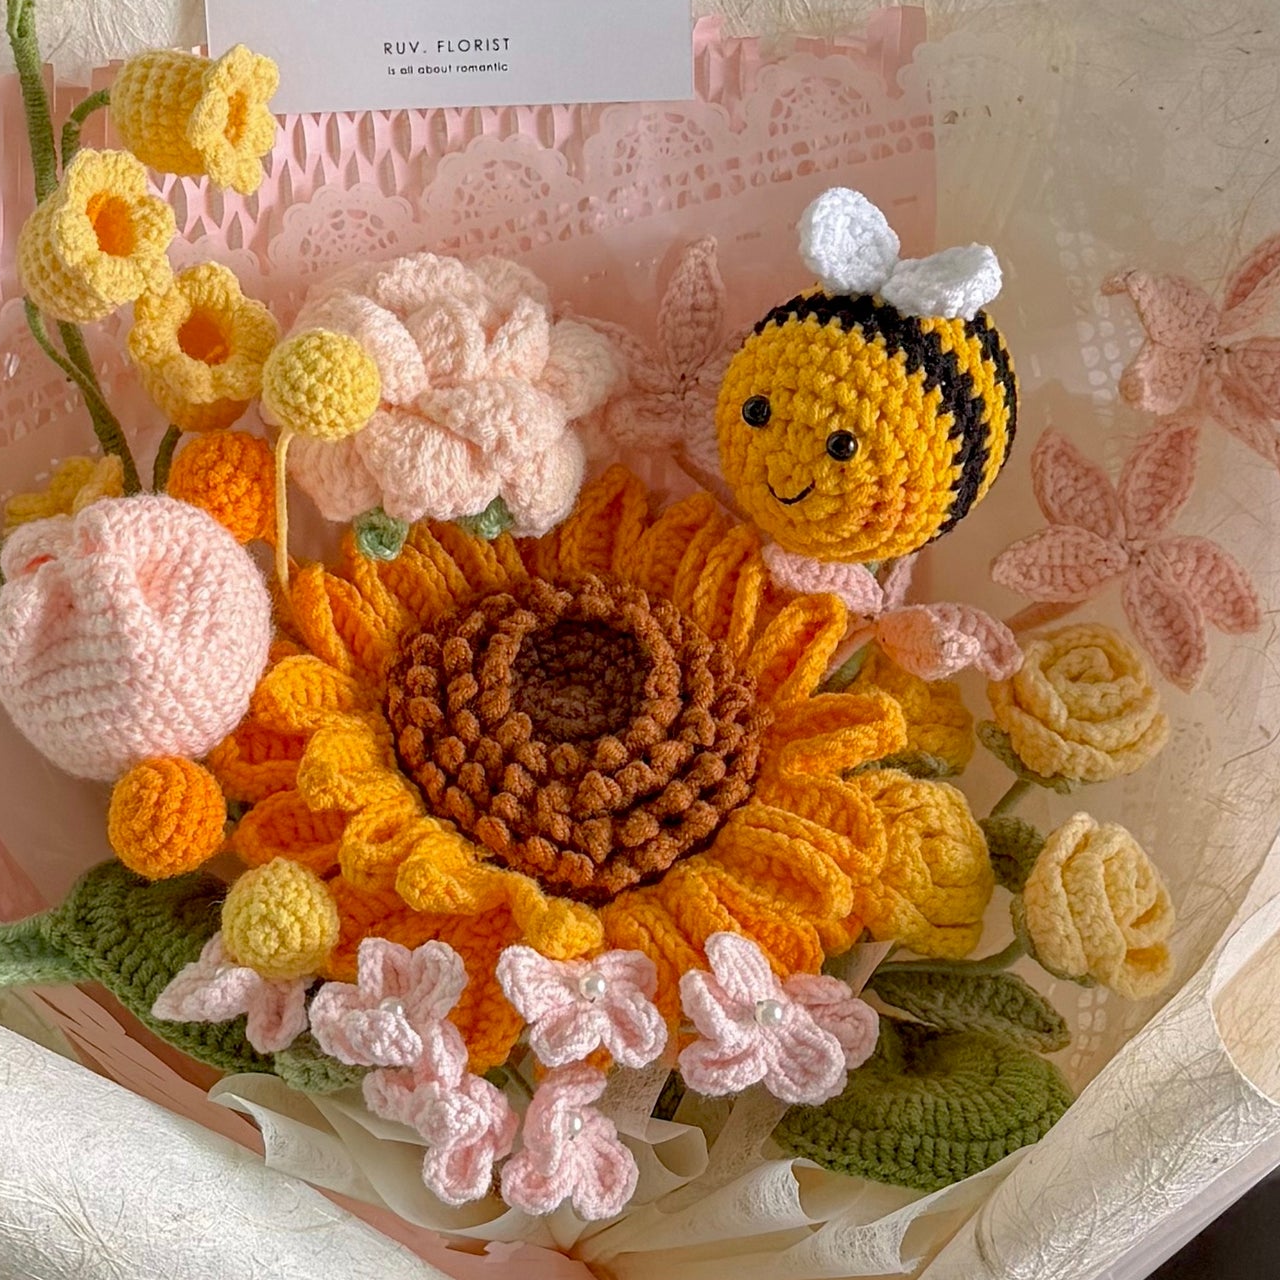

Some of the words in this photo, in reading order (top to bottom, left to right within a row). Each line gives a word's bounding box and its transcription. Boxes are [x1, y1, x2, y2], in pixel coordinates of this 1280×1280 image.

[383, 40, 427, 55] RUV.
[436, 37, 510, 53] FLORIST
[387, 66, 396, 76] is
[399, 65, 414, 75] all
[417, 64, 452, 75] about
[455, 61, 509, 73] romantic
